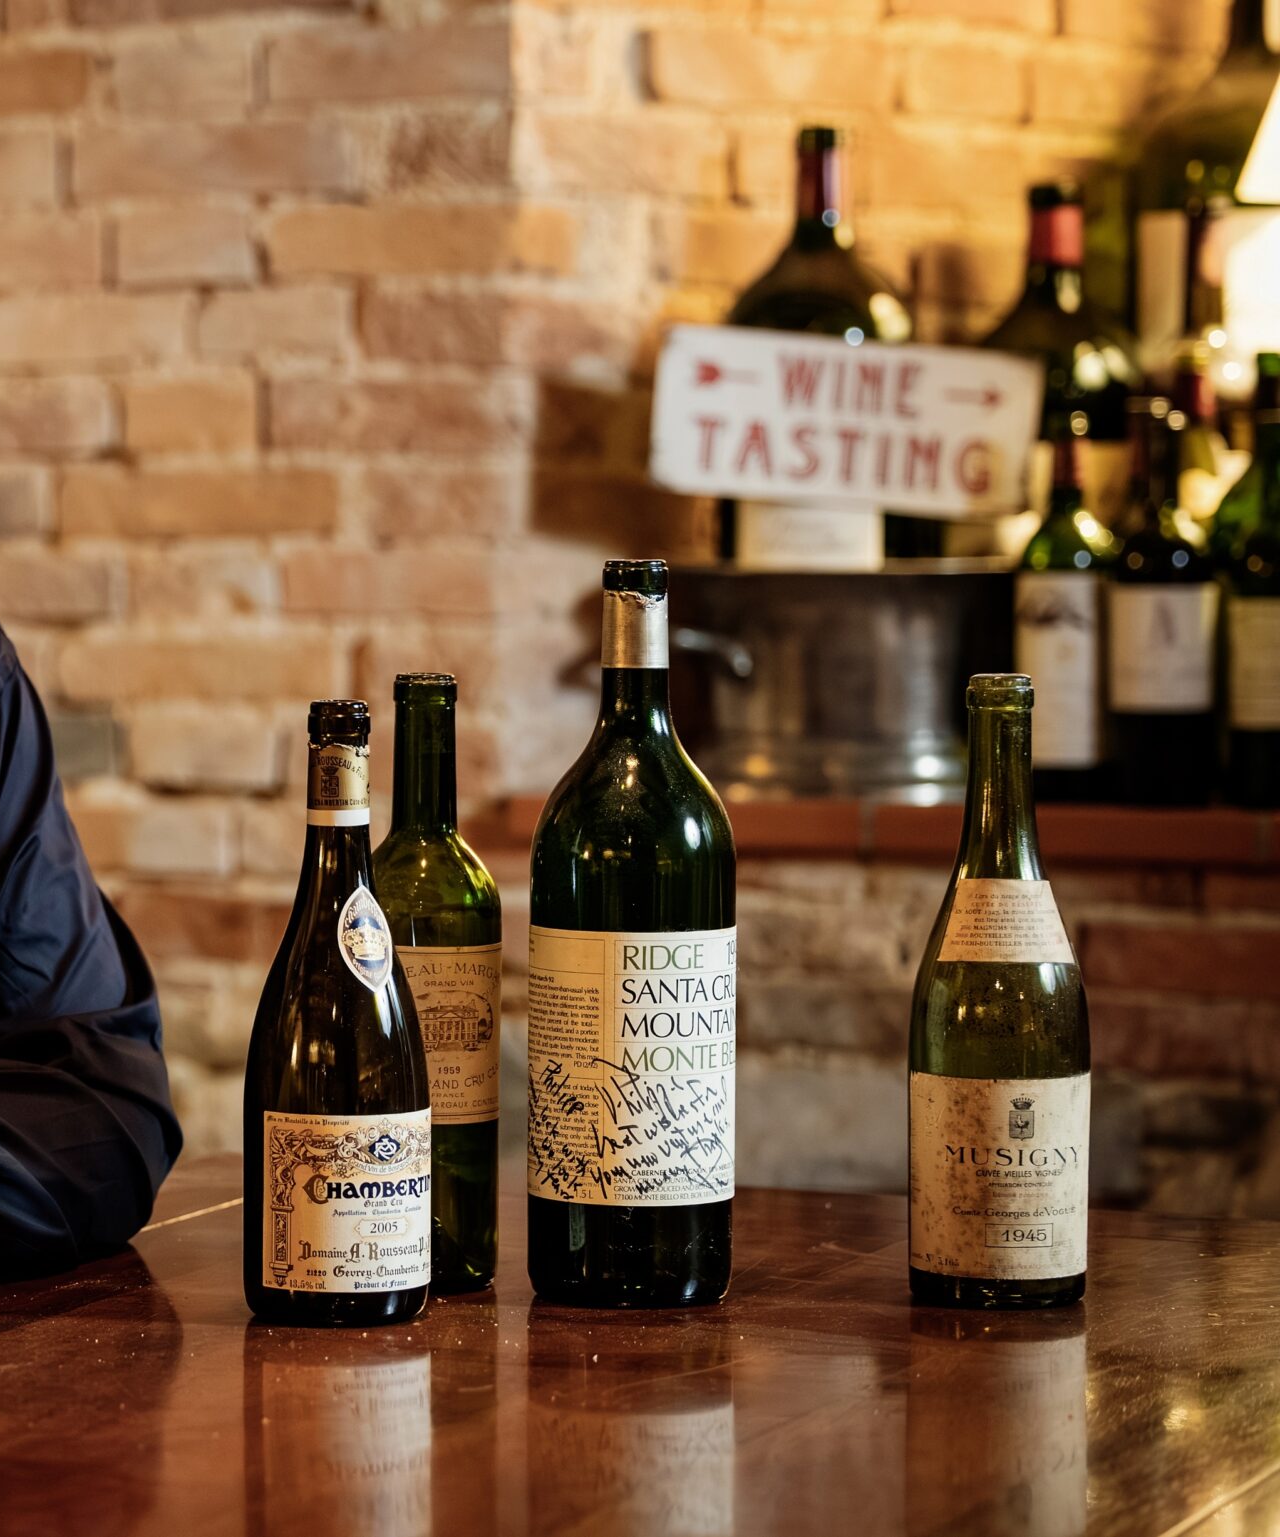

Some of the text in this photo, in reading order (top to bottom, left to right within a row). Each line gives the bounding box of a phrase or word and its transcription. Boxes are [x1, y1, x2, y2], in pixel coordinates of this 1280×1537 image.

[778, 354, 923, 419] WINE
[694, 415, 993, 495] TASTING
[623, 940, 735, 970] RIDGE 19
[622, 977, 709, 1004] SANTA
[622, 1044, 717, 1072] MONTE
[438, 1065, 461, 1075] 1959
[429, 1073, 485, 1089] AND CRU
[945, 1145, 1081, 1167] MUSIGNY
[976, 1169, 1000, 1177] CUVÉE
[363, 1199, 387, 1208] Grand
[634, 1193, 659, 1201] MONTE
[332, 1209, 367, 1217] Appellation
[984, 1207, 1030, 1219] Georges
[1032, 1208, 1043, 1217] de
[370, 1221, 398, 1234] 2005
[1001, 1229, 1047, 1243] 1945
[298, 1240, 347, 1261] Domaine
[345, 1243, 365, 1263] A.
[367, 1241, 418, 1261] Rousseau
[306, 1269, 327, 1277] 21220
[333, 1264, 419, 1280] Gevrey-Chambertin
[289, 1279, 313, 1289] 13.5%
[354, 1281, 379, 1289] Product
